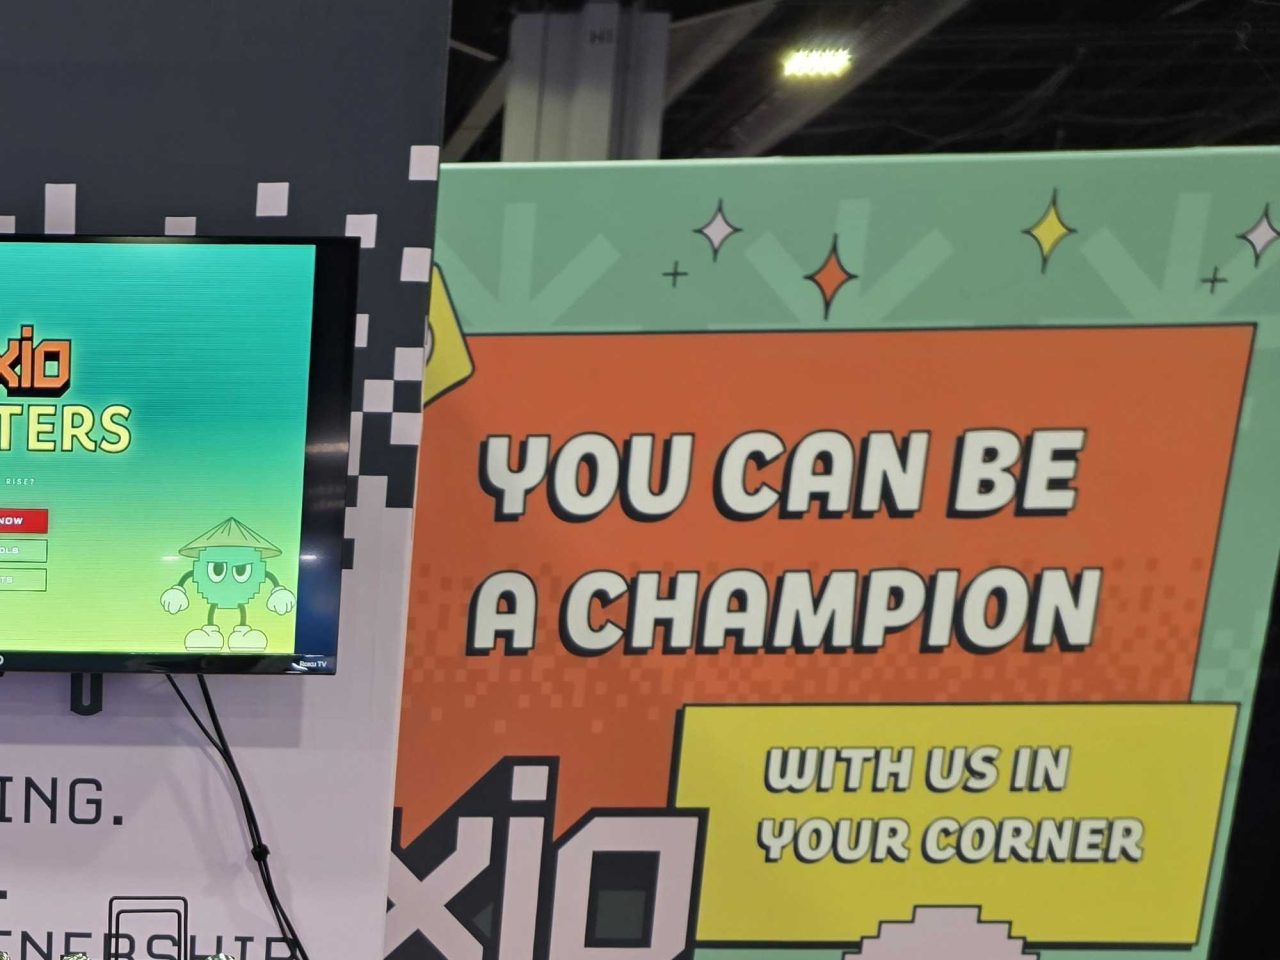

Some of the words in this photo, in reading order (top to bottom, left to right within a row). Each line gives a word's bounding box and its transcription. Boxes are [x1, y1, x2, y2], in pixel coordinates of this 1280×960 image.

[6, 478, 35, 486] RISE?
[478, 431, 695, 523] YOU
[712, 429, 931, 521] CAN
[946, 427, 1089, 519] BE
[465, 570, 538, 657] A
[557, 567, 1104, 657] CHAMPION
[763, 746, 916, 795] WITH
[923, 746, 1003, 794] US
[1011, 745, 1073, 793] IN
[757, 818, 913, 865] YOUR
[919, 818, 1146, 864] CORNER
